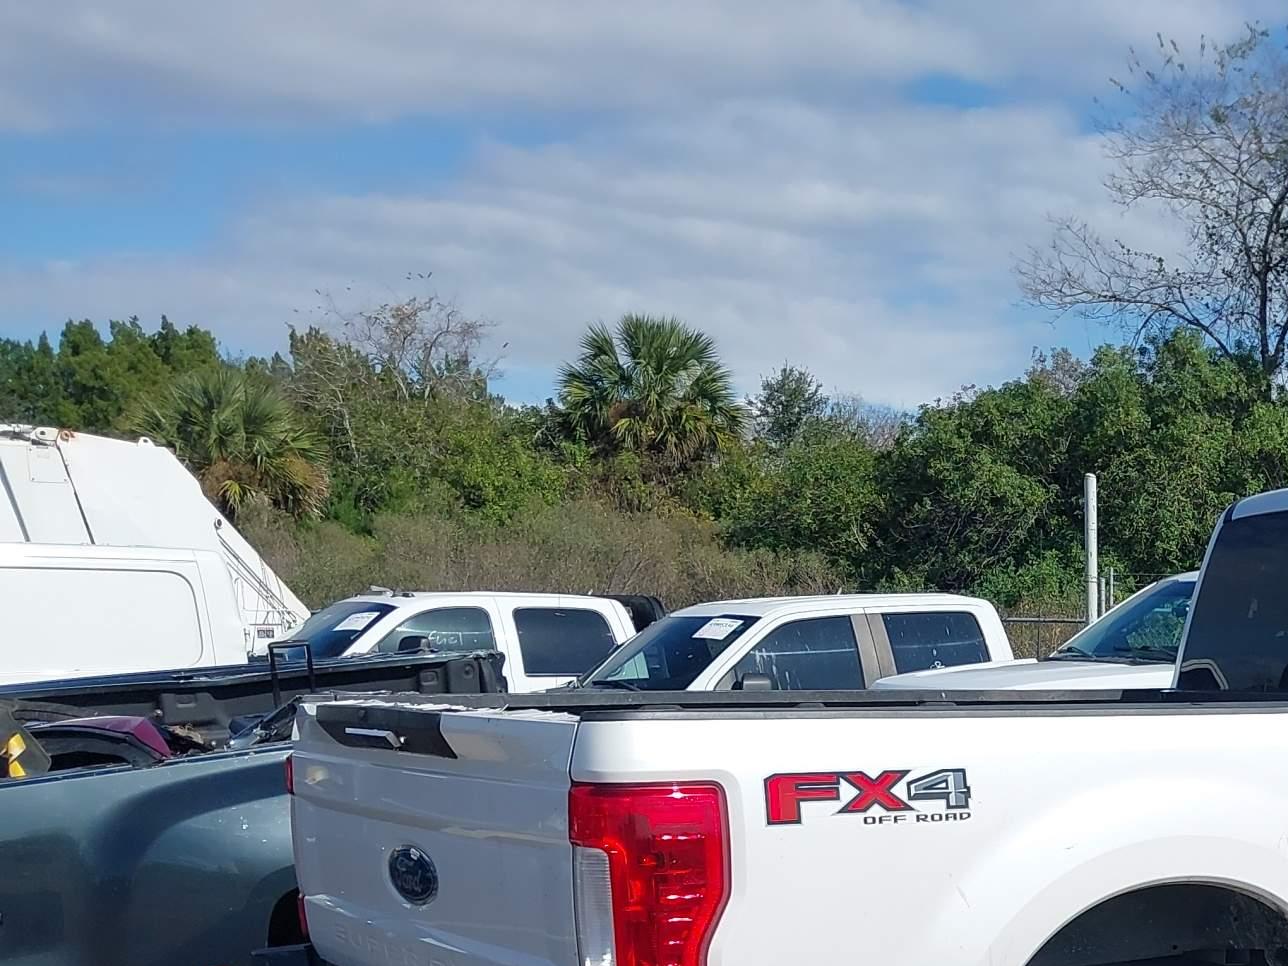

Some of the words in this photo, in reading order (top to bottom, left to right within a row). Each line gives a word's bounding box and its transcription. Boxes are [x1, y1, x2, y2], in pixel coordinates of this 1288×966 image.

[763, 768, 971, 825] FX4
[863, 814, 907, 825] OFF
[915, 811, 972, 823] ROAD
